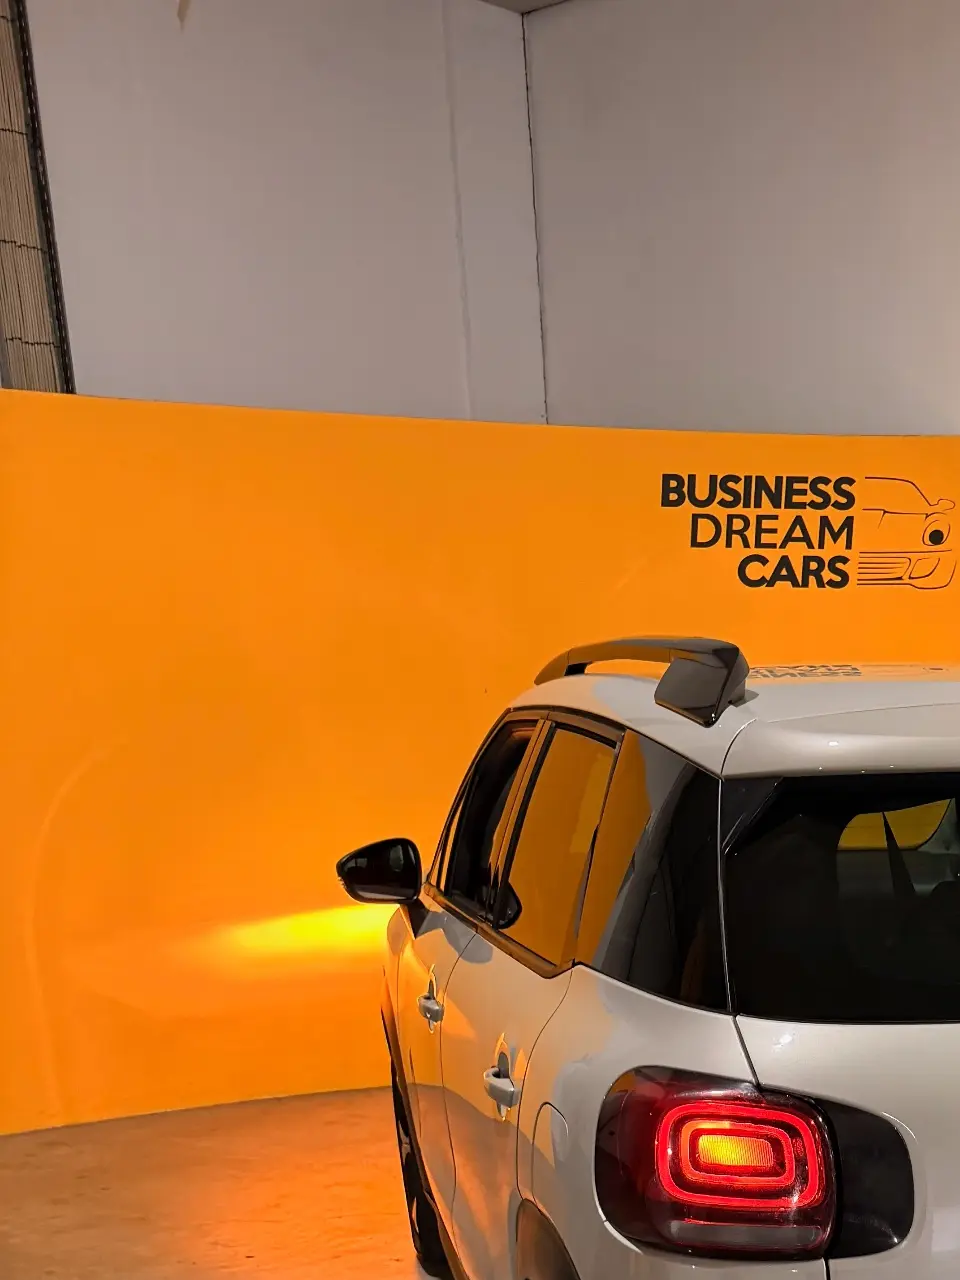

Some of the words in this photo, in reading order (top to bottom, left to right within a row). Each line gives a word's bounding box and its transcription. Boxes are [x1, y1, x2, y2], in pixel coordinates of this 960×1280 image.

[660, 473, 857, 511] BUSINESS
[690, 513, 855, 551] DREAM
[737, 554, 851, 589] CARS
